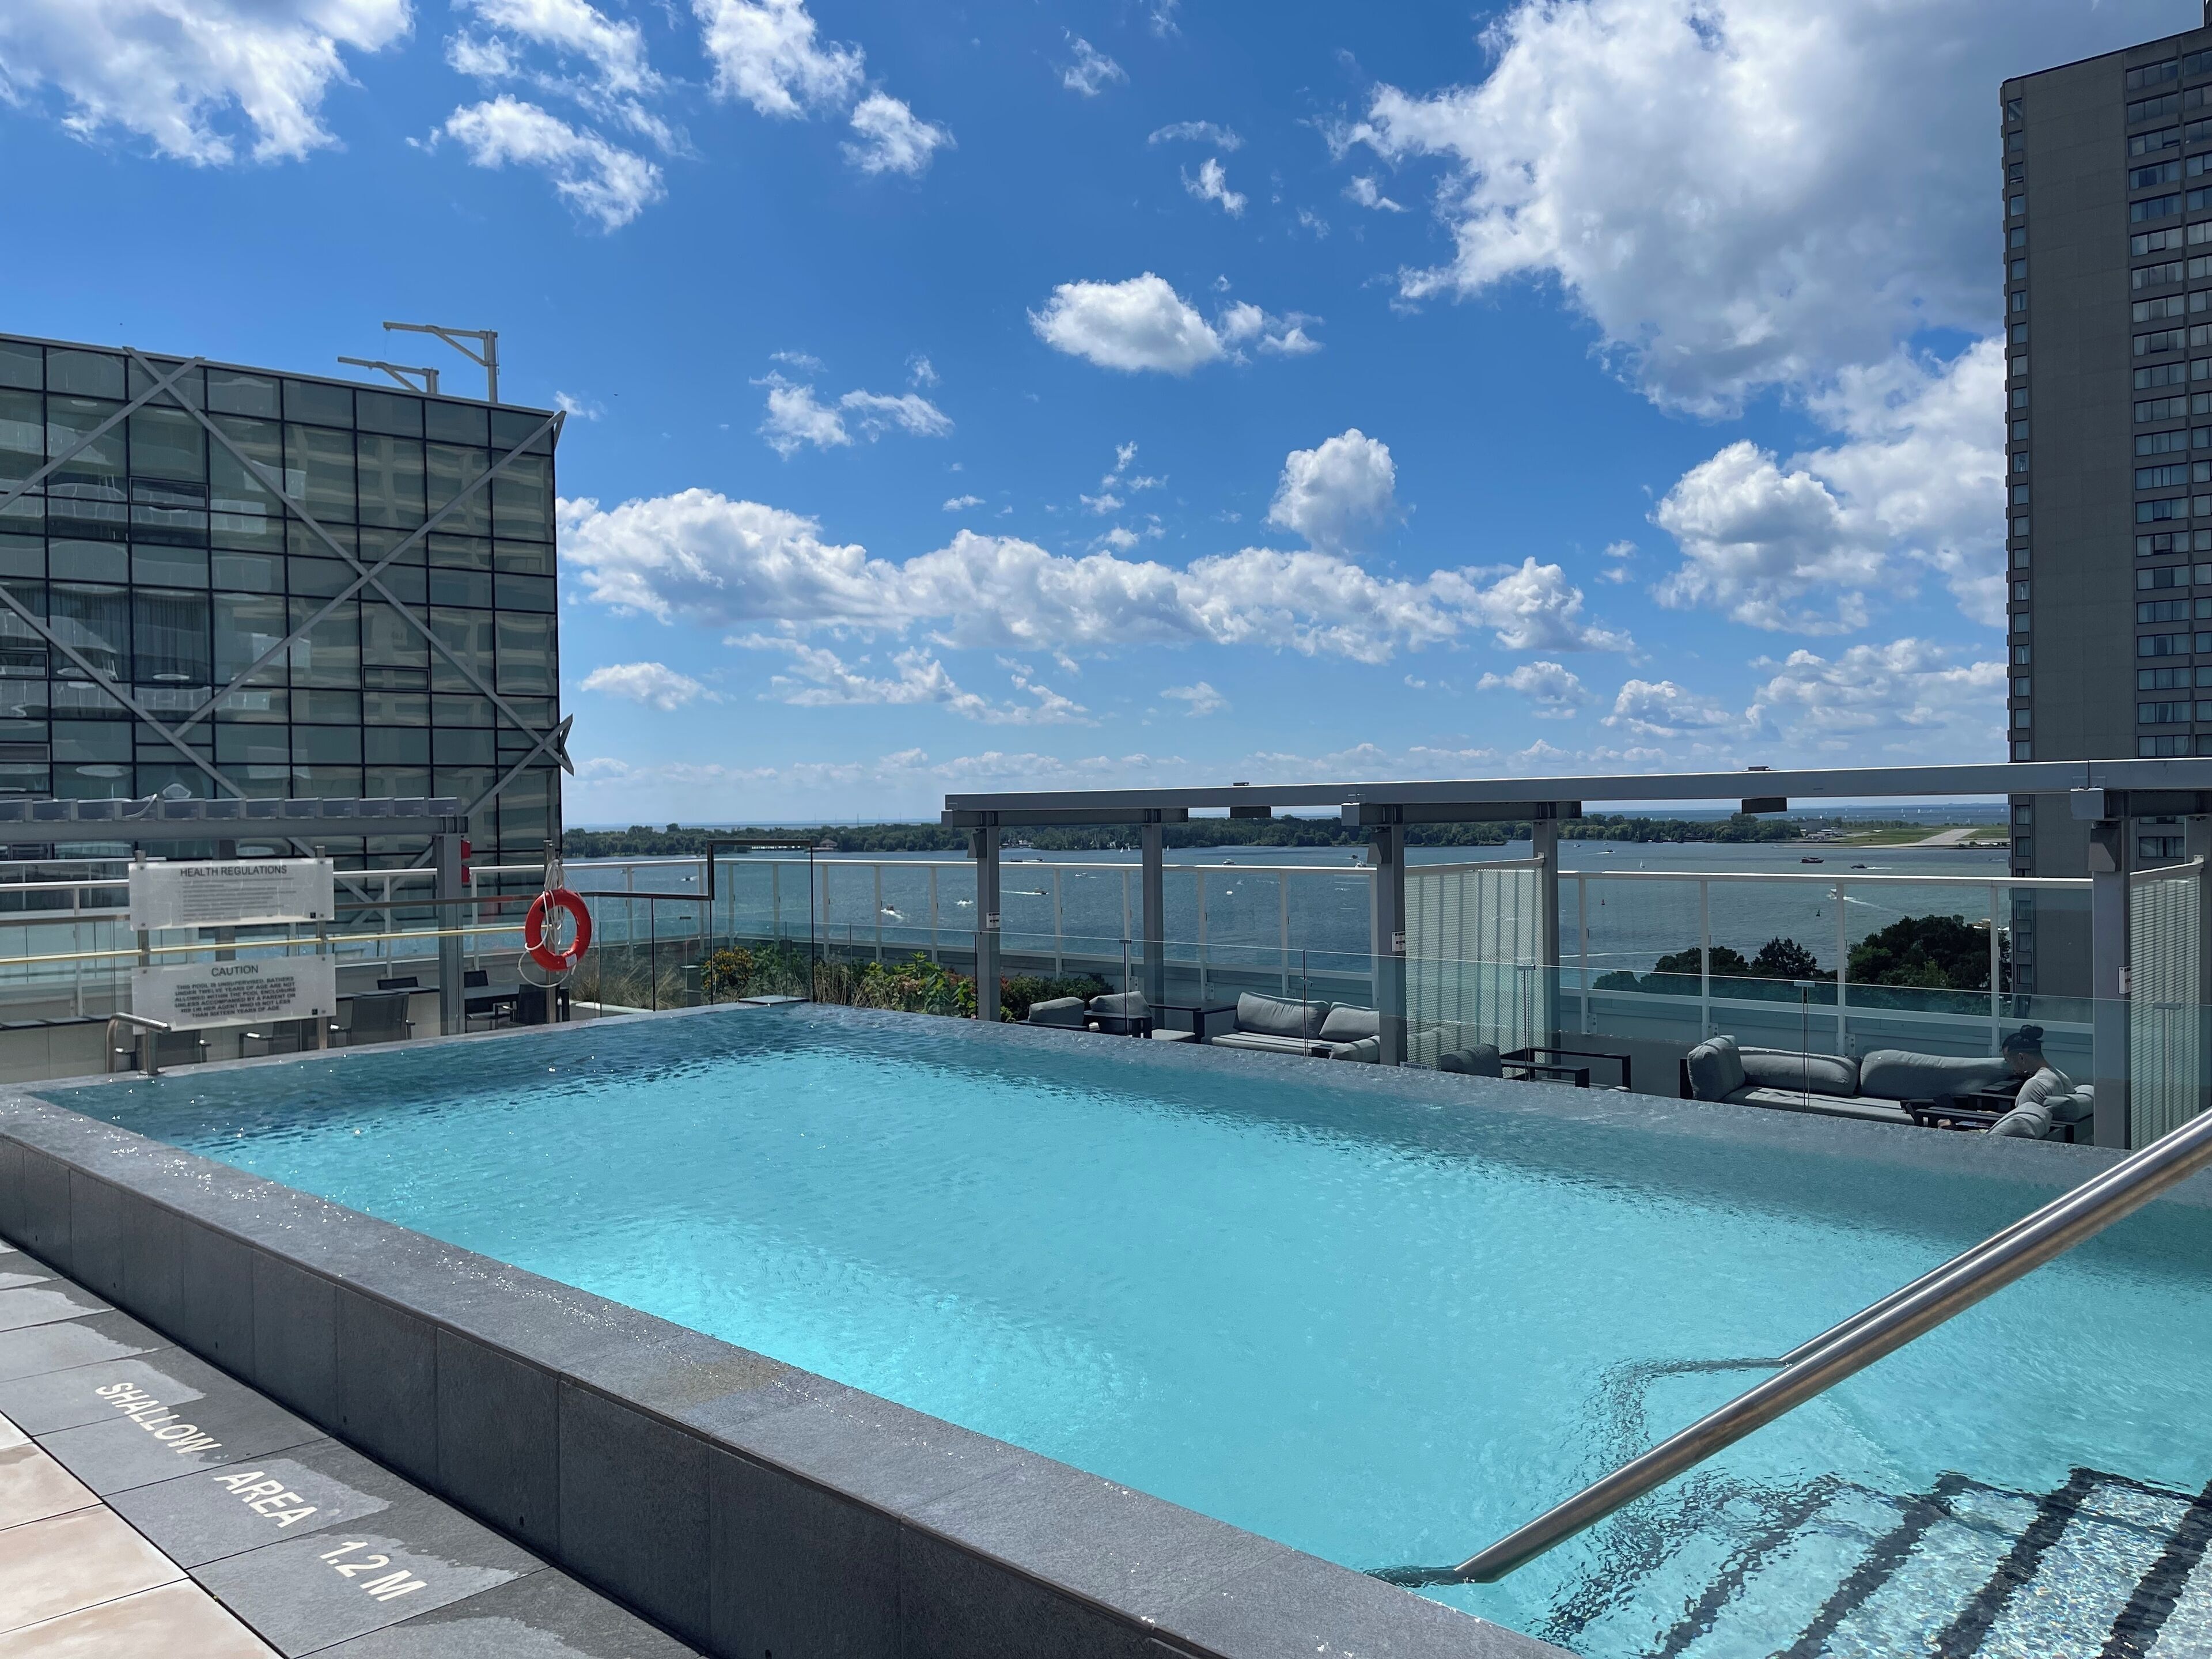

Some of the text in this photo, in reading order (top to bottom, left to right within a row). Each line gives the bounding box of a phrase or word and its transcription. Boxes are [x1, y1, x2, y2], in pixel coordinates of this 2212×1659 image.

[180, 865, 287, 877] HEALTH REGULATIONS
[211, 964, 259, 976] CAUTION
[95, 1382, 222, 1454] SHALLOW
[214, 1471, 318, 1528] AREA
[319, 1541, 427, 1601] 1.2 M
